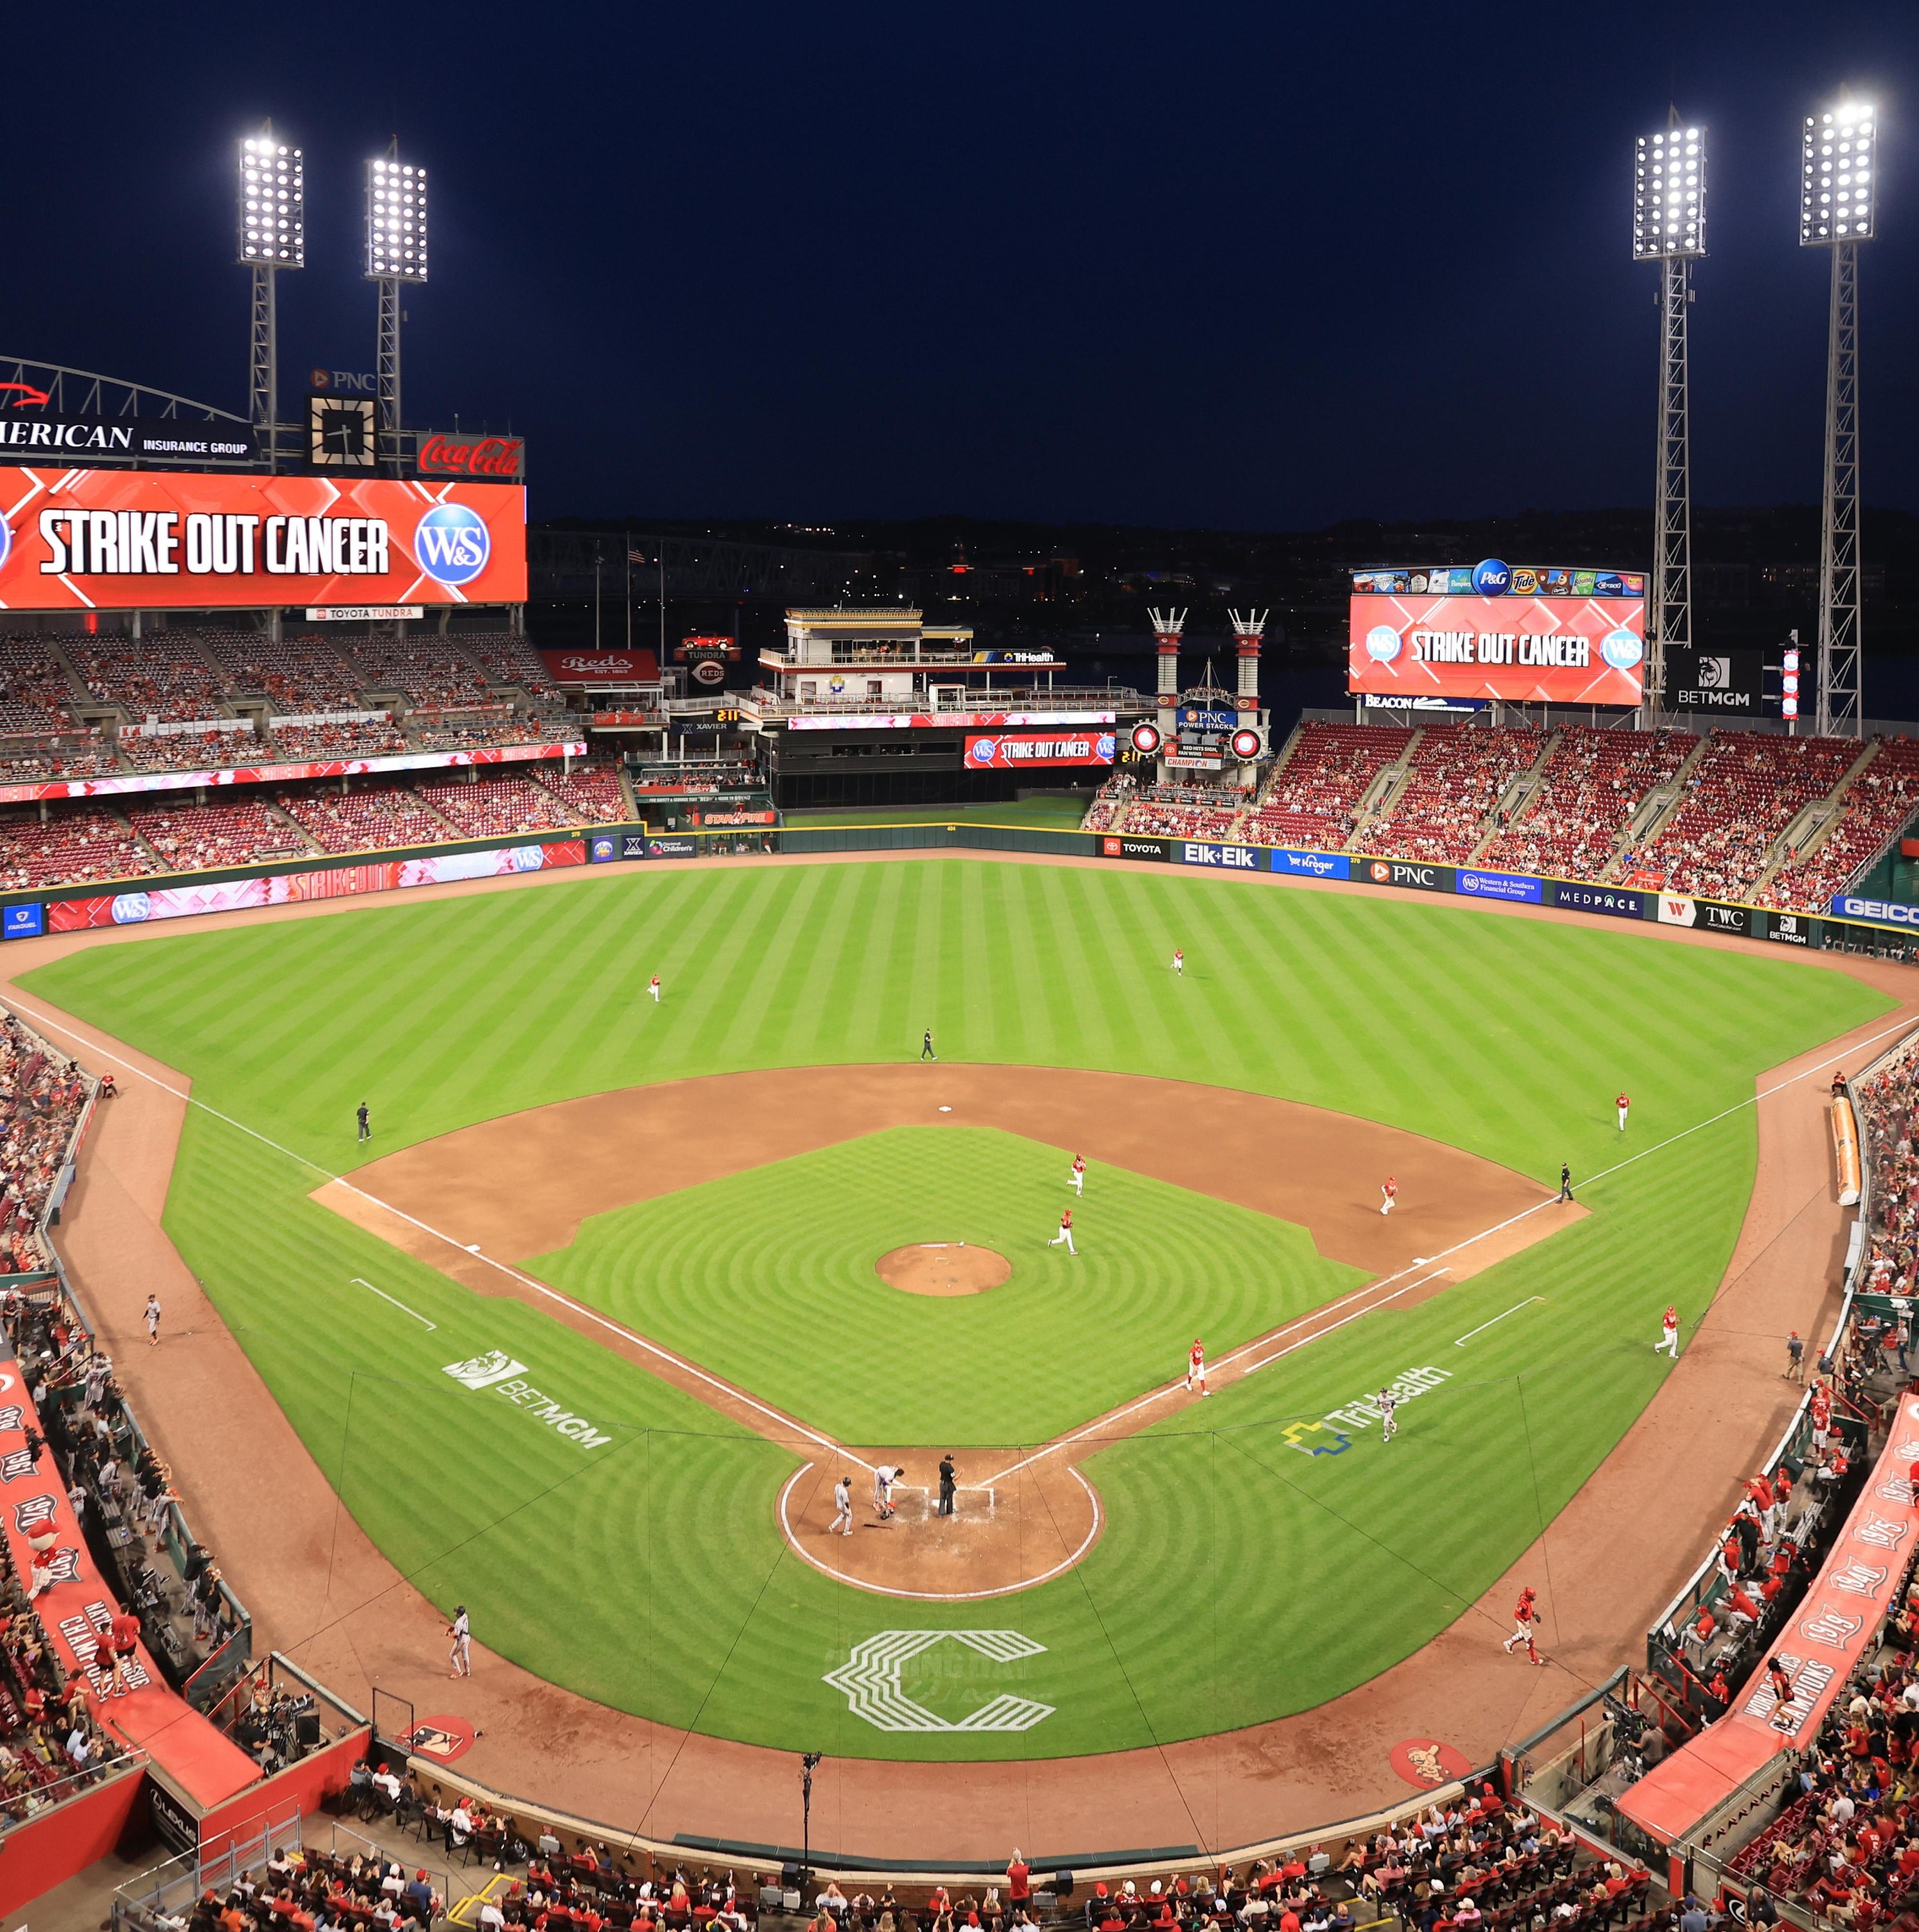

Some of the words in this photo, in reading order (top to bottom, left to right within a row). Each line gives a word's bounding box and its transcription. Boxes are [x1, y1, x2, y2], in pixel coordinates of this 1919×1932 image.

[333, 371, 376, 390] PNC
[0, 421, 134, 449] ERICAN
[143, 440, 208, 453] INSURANCE
[210, 442, 248, 454] GROUP
[40, 509, 179, 573] STRIKE
[186, 514, 259, 573] OUT
[266, 517, 389, 573] CANCER
[421, 526, 483, 566] W&S
[1480, 572, 1507, 585] P&G
[1514, 575, 1535, 590] Tide
[330, 609, 369, 618] TOYOTA
[372, 609, 413, 617] TUNDRA
[1013, 652, 1054, 663] TriHealth
[1411, 631, 1474, 663] STRIKE
[1478, 633, 1516, 665] OUT
[1519, 634, 1590, 667] CANCER
[561, 654, 634, 672] Reds
[1365, 694, 1412, 709] BEACON
[1678, 690, 1749, 707] BETMGM
[1199, 713, 1227, 724] PNC
[975, 746, 993, 757] W&S
[1000, 742, 1033, 758] STRIKE
[1035, 742, 1054, 757] OUT
[1055, 741, 1090, 757] CANCER
[704, 814, 732, 824] STAR
[741, 812, 767, 824] FIRE
[1123, 843, 1162, 854] TOYOTA
[1303, 855, 1335, 874] Kroger
[1392, 865, 1434, 886] PNC
[1479, 877, 1502, 886] Western
[1510, 881, 1534, 890] Southern
[1480, 884, 1506, 893] Financial
[1507, 888, 1526, 896] Group
[114, 899, 146, 919] W&S
[1560, 890, 1636, 911] MEDPACE
[1706, 907, 1744, 927] TWC
[1769, 931, 1806, 944] BETMGM
[496, 1379, 612, 1449] BETMGM
[5, 1449, 32, 1476] 1961
[1859, 1516, 1905, 1547] 1975
[1837, 1564, 1880, 1594] 1940
[1808, 1612, 1856, 1644] 1919
